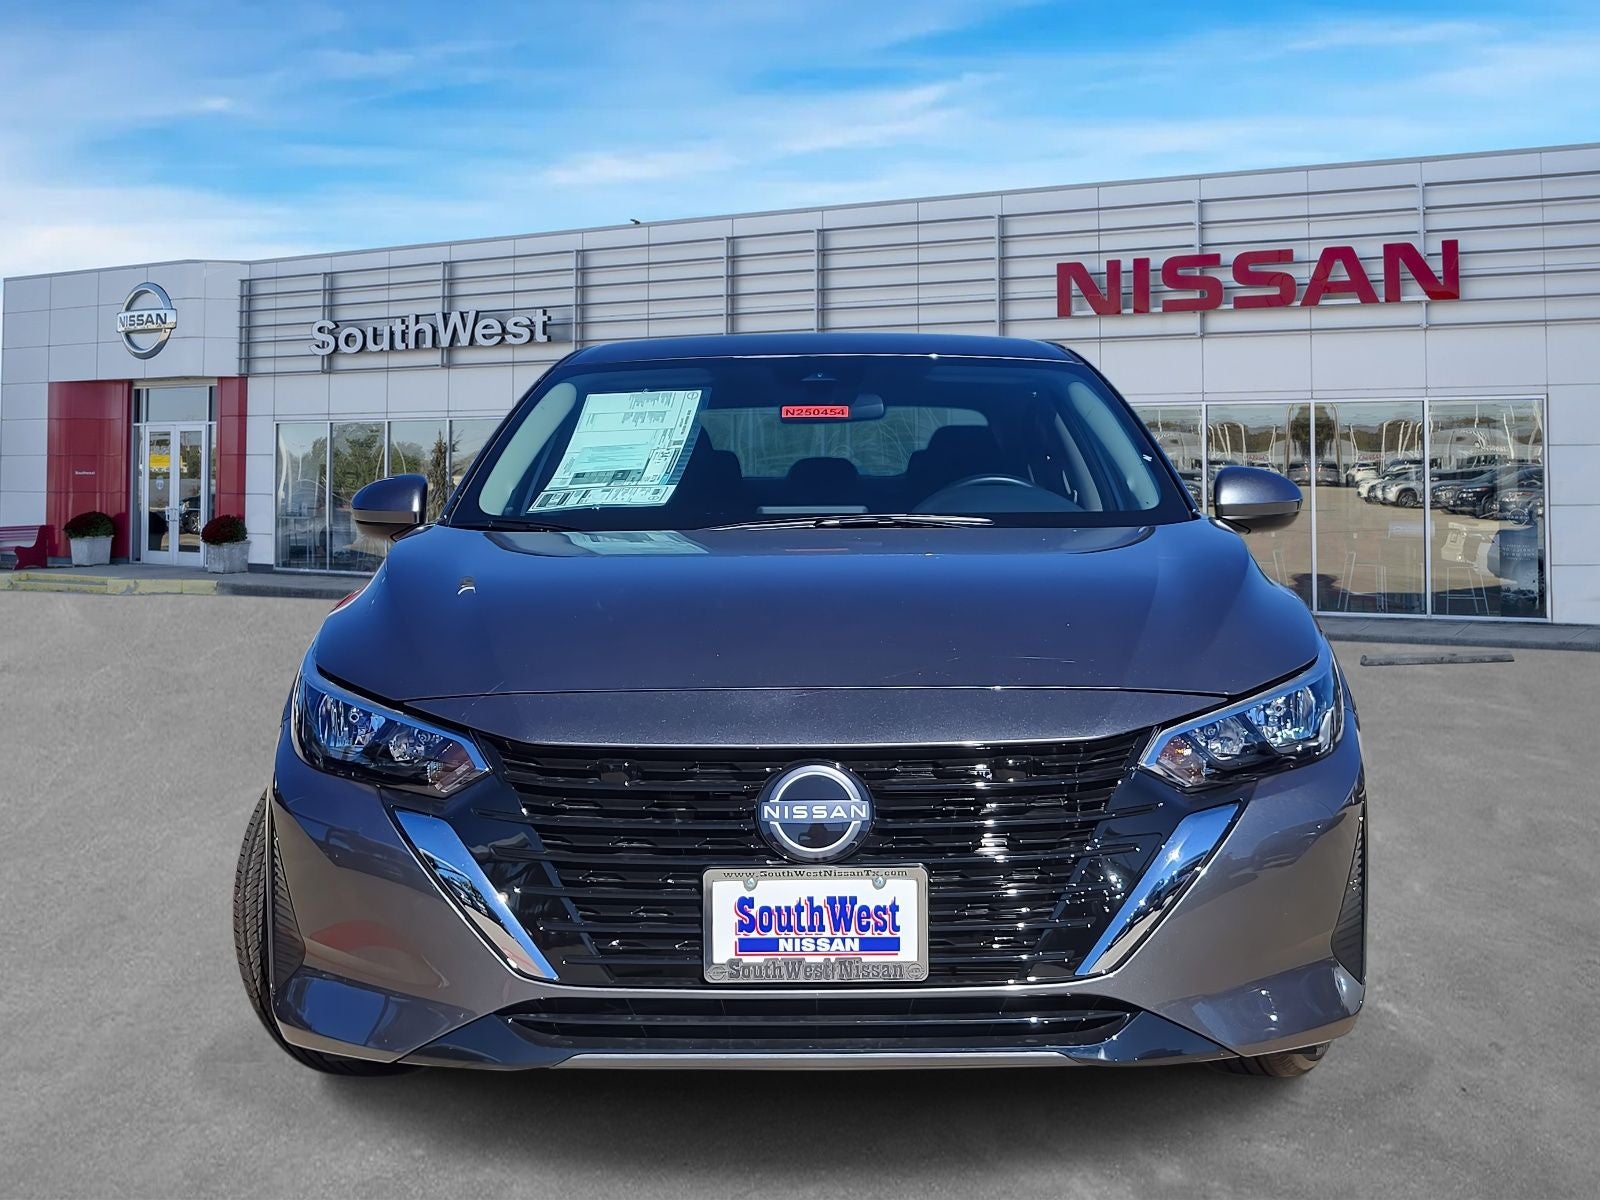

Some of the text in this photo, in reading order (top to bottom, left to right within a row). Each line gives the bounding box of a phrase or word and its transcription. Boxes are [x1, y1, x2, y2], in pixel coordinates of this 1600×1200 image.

[1056, 239, 1460, 318] NISSAN
[118, 312, 167, 329] NISSAN
[310, 308, 551, 356] SouthWest
[785, 408, 845, 416] N250454
[763, 804, 867, 820] NISSAN
[734, 895, 901, 936] SouthWest
[778, 938, 860, 951] NISSAN
[728, 960, 833, 979] SouthWest
[837, 960, 904, 979] Nissan
